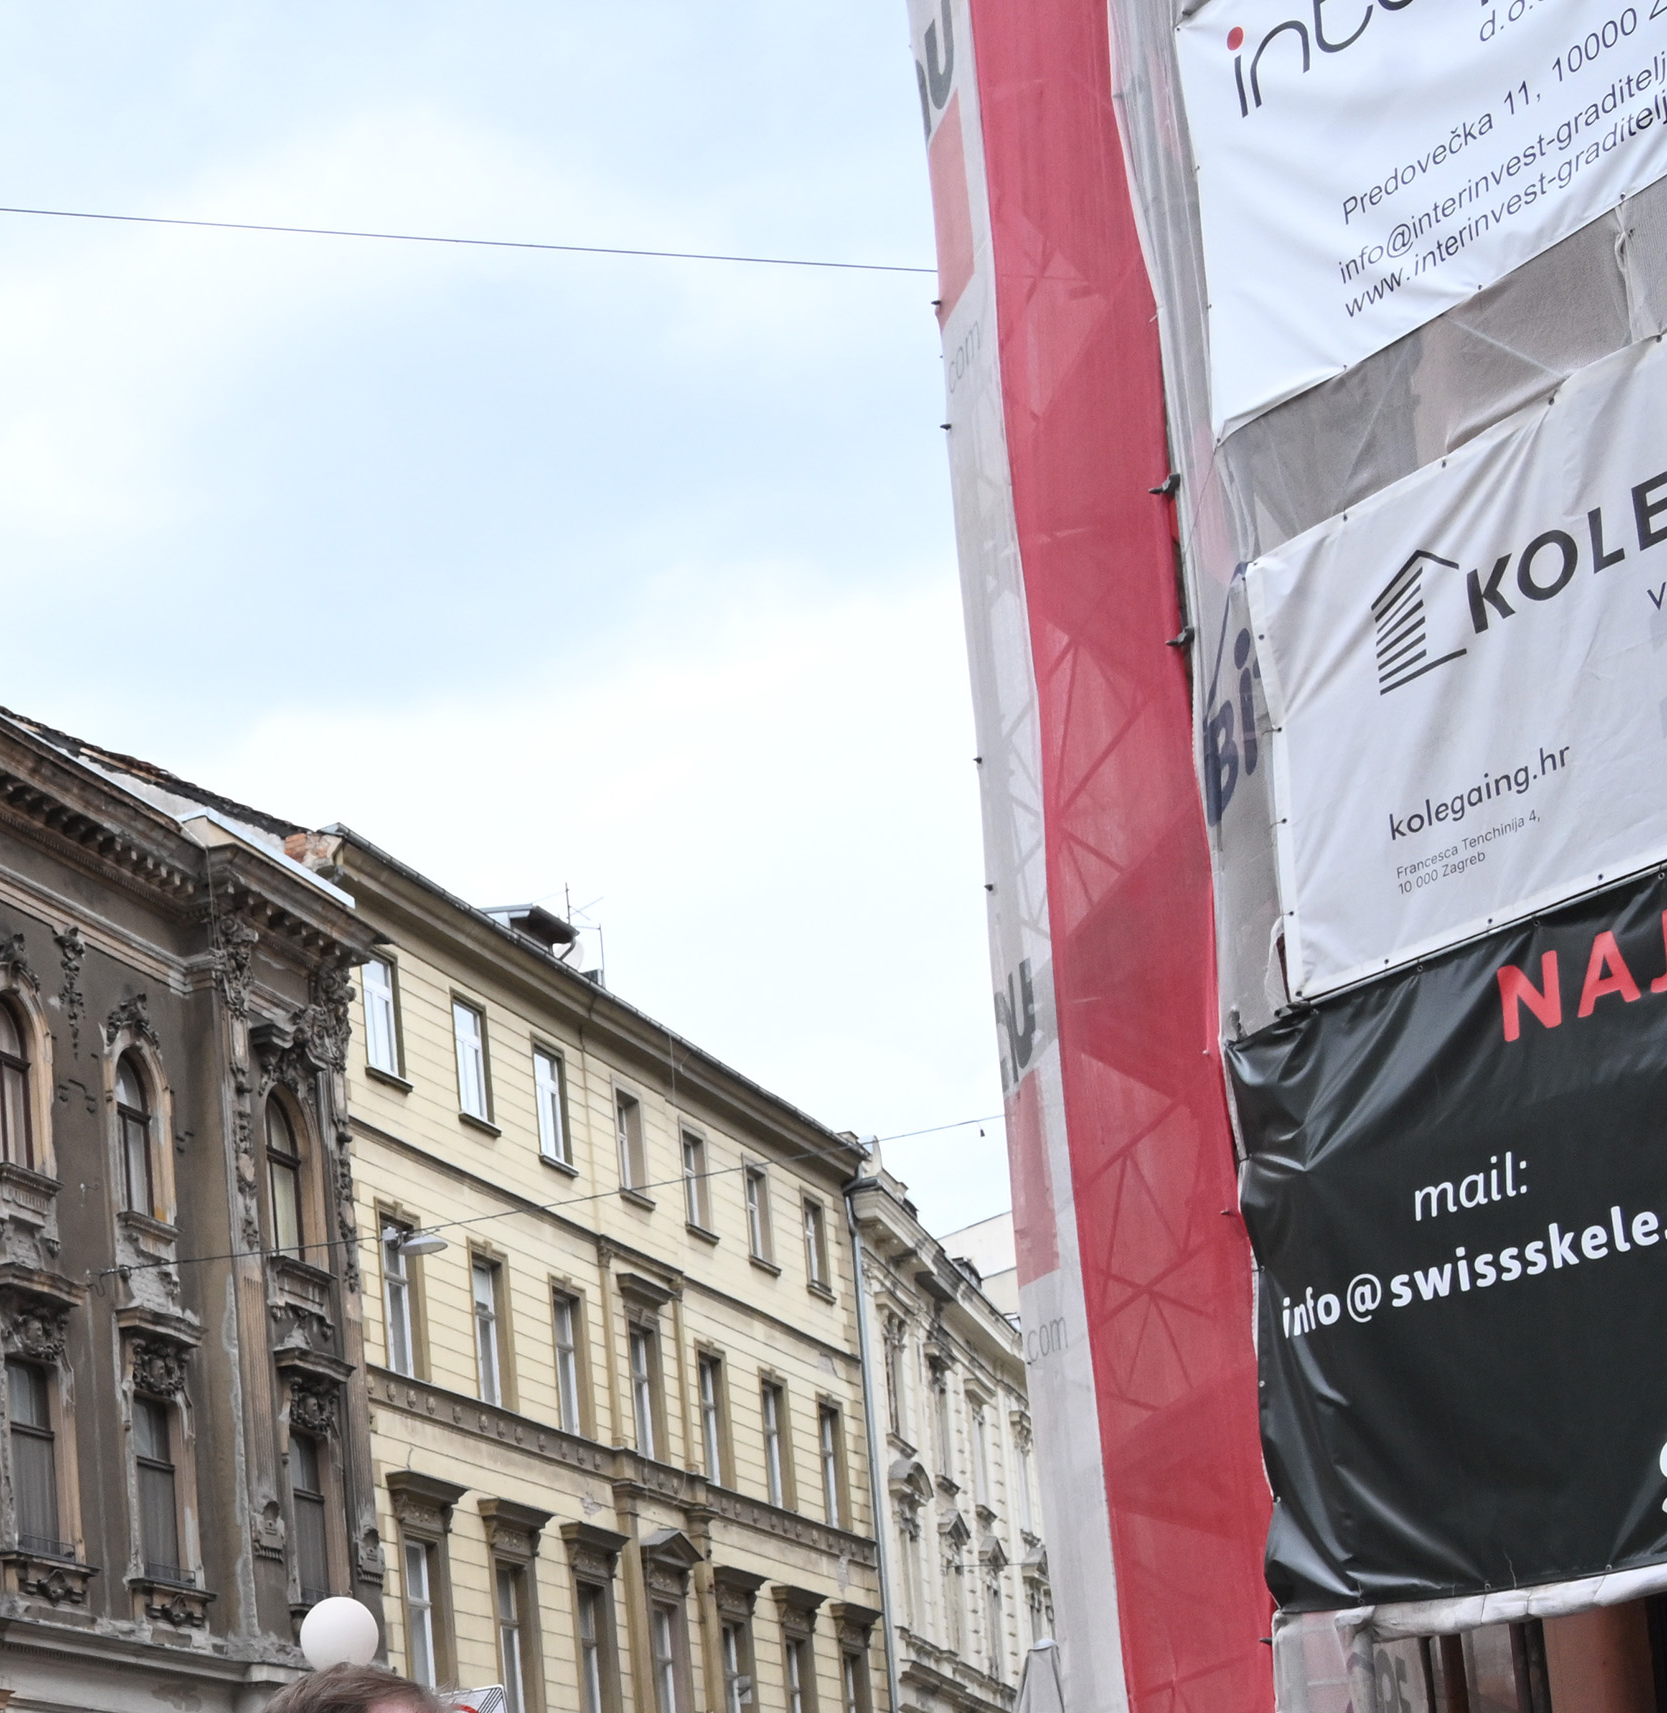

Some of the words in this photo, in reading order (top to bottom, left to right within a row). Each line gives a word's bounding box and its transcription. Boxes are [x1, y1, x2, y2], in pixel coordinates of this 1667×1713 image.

[1342, 113, 1494, 225] Predovečka
[1503, 80, 1542, 115] 11,
[1552, 8, 1638, 82] 10000
[1389, 746, 1570, 841] kolegaing.hr
[1396, 846, 1459, 879] Francesca
[1461, 815, 1525, 851] Tenchinija
[1528, 808, 1541, 824] 4,
[1398, 879, 1412, 895] 10
[1415, 873, 1439, 889] 000
[1442, 850, 1486, 878] Zagreb
[1414, 1151, 1528, 1222] mail:
[1282, 1205, 1667, 1339] info@swissskele
